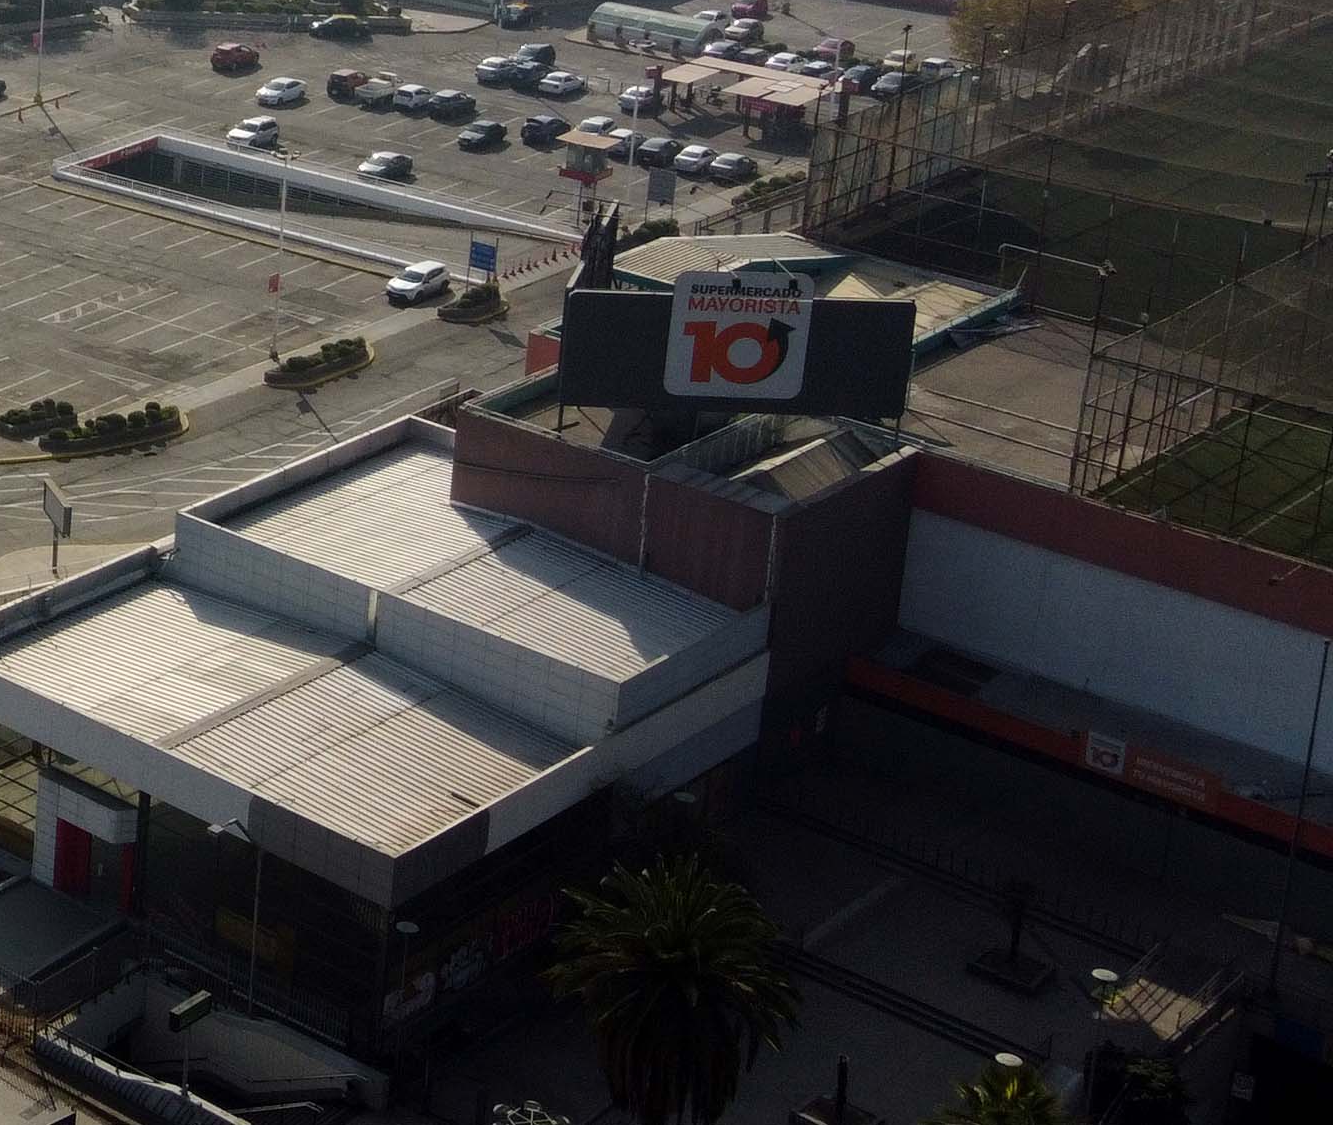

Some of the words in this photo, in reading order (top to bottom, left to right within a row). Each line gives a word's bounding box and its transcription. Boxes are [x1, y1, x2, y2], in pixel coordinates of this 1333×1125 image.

[691, 284, 803, 299] SUPERMERCADO
[688, 297, 802, 315] MAYORISTA
[683, 320, 790, 385] 10
